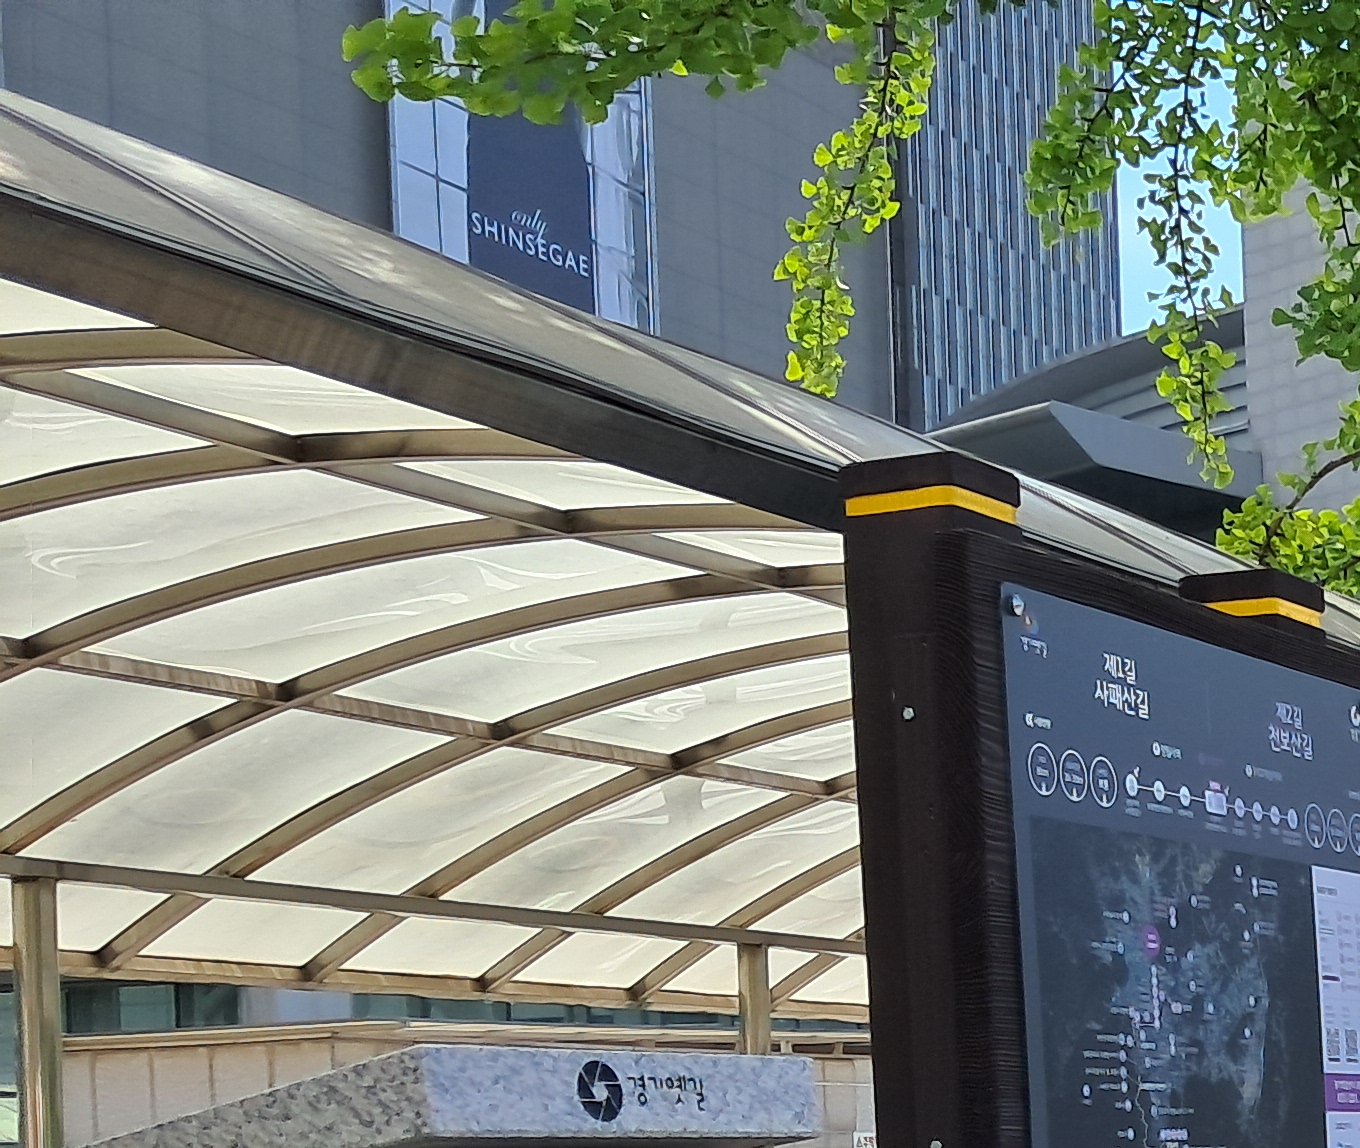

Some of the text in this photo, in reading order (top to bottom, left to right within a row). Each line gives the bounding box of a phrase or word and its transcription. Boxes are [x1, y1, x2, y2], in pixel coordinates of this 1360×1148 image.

[471, 211, 590, 278] SHINSEGAE
[511, 208, 548, 244] only
[1094, 679, 1151, 721] 사패산길
[1267, 723, 1314, 761] 천보산길
[627, 1074, 706, 1112] 경기옛길
